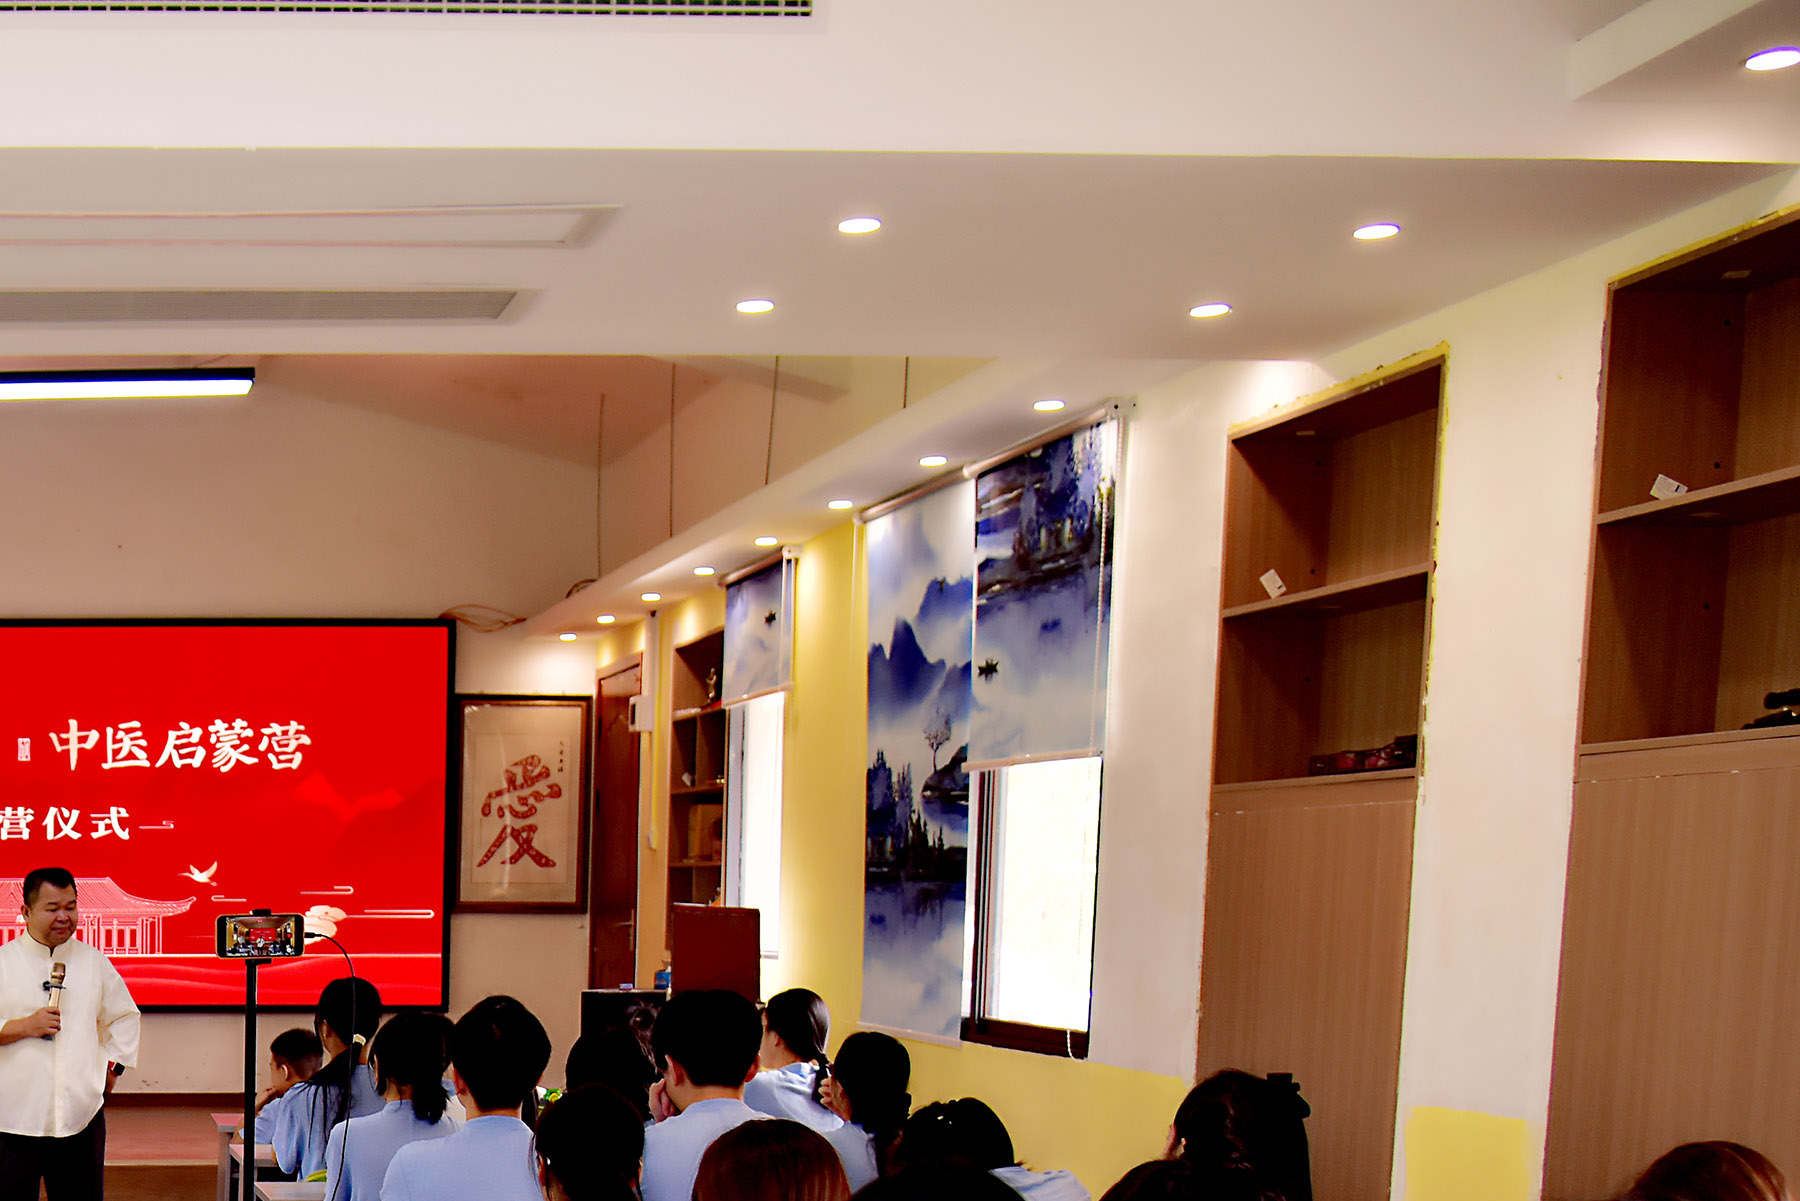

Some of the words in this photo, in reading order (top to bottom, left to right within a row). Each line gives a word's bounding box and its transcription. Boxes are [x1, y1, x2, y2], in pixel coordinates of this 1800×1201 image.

[48, 718, 312, 773] 中医启蒙营
